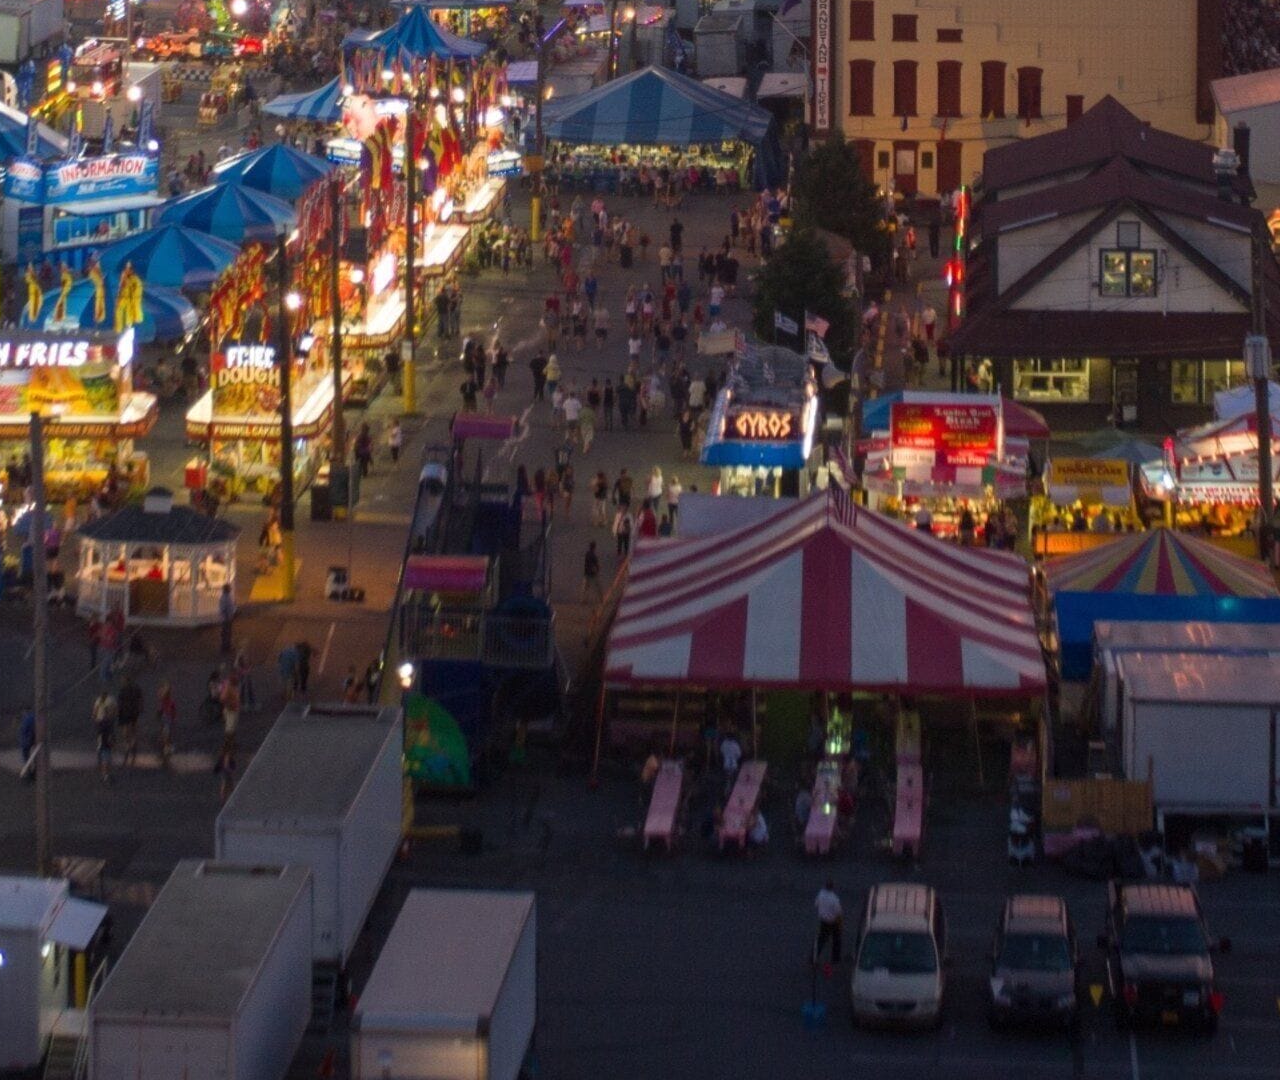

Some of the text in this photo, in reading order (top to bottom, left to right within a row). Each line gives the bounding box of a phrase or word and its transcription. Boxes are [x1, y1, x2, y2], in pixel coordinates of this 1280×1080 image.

[61, 159, 145, 183] INFORMATION
[15, 341, 90, 367] FRIES
[219, 367, 281, 387] DOUGH
[736, 411, 792, 438] GYROS
